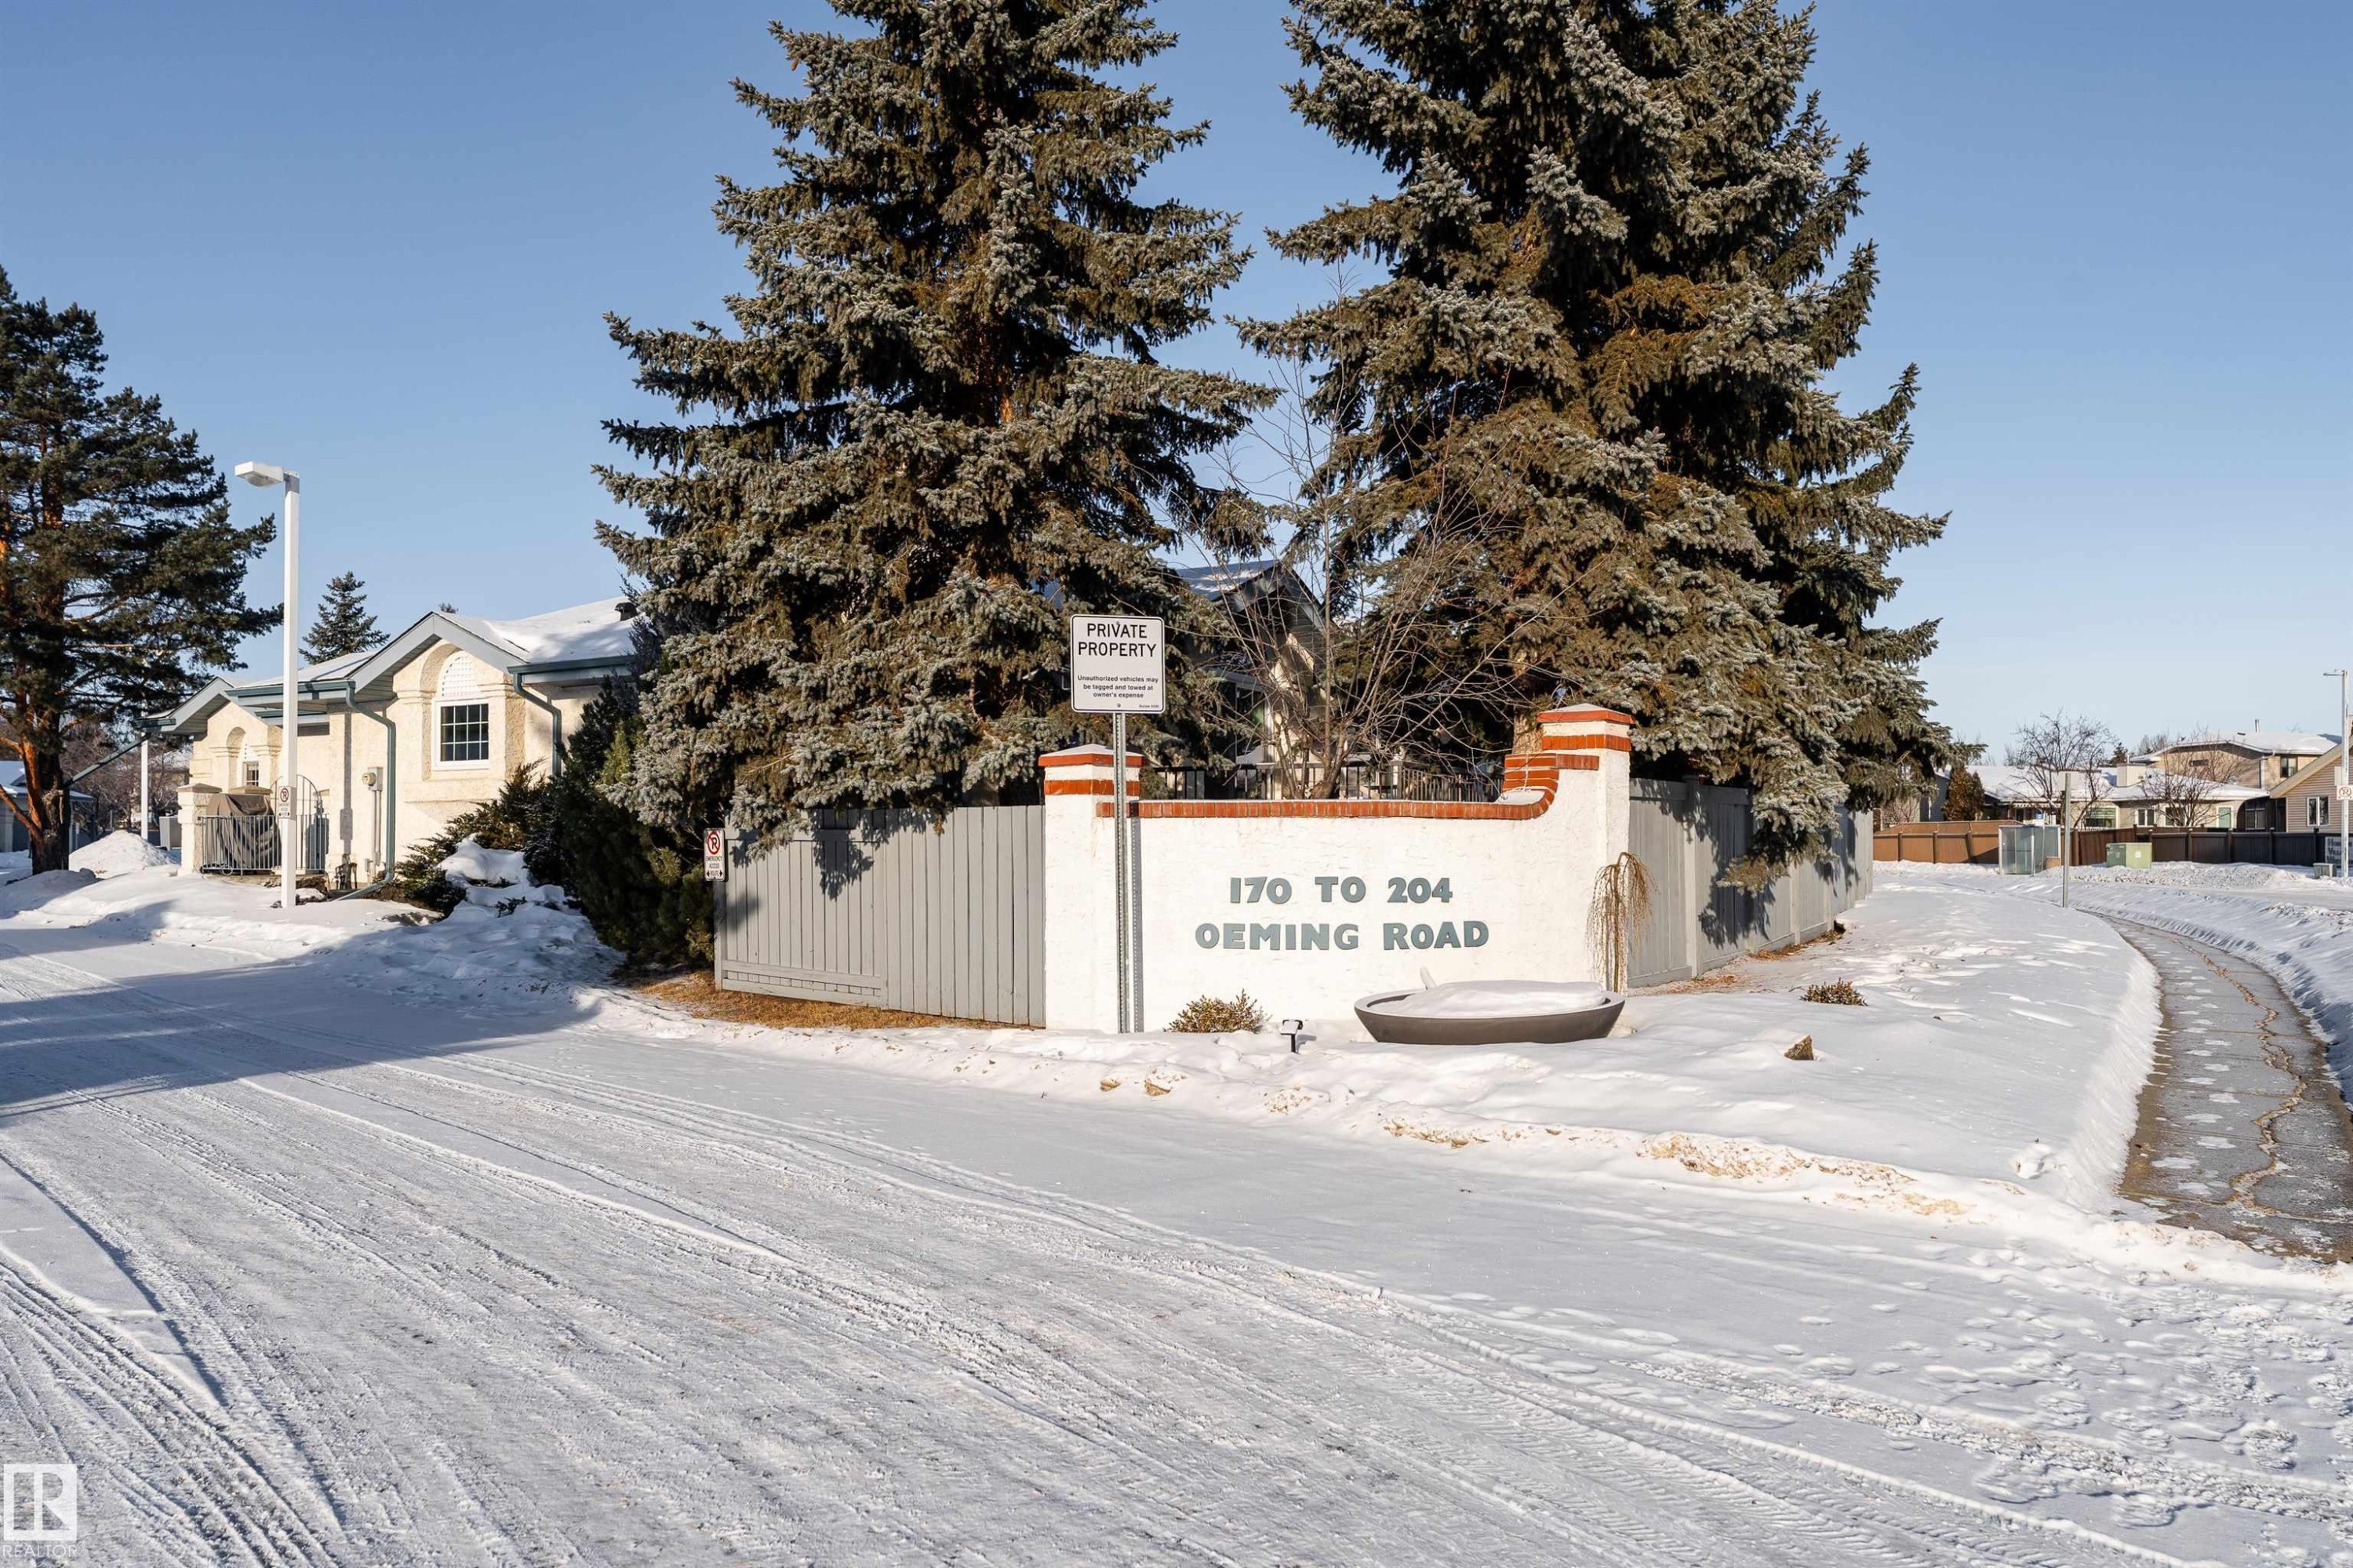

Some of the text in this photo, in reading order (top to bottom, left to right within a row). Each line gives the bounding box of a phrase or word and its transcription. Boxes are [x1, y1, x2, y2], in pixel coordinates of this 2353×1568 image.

[1087, 623, 1147, 638] PRIVATE
[1078, 642, 1157, 657] PROPERTY
[1230, 875, 1453, 904] 170 TO 204
[1195, 920, 1489, 950] OEMING ROAD
